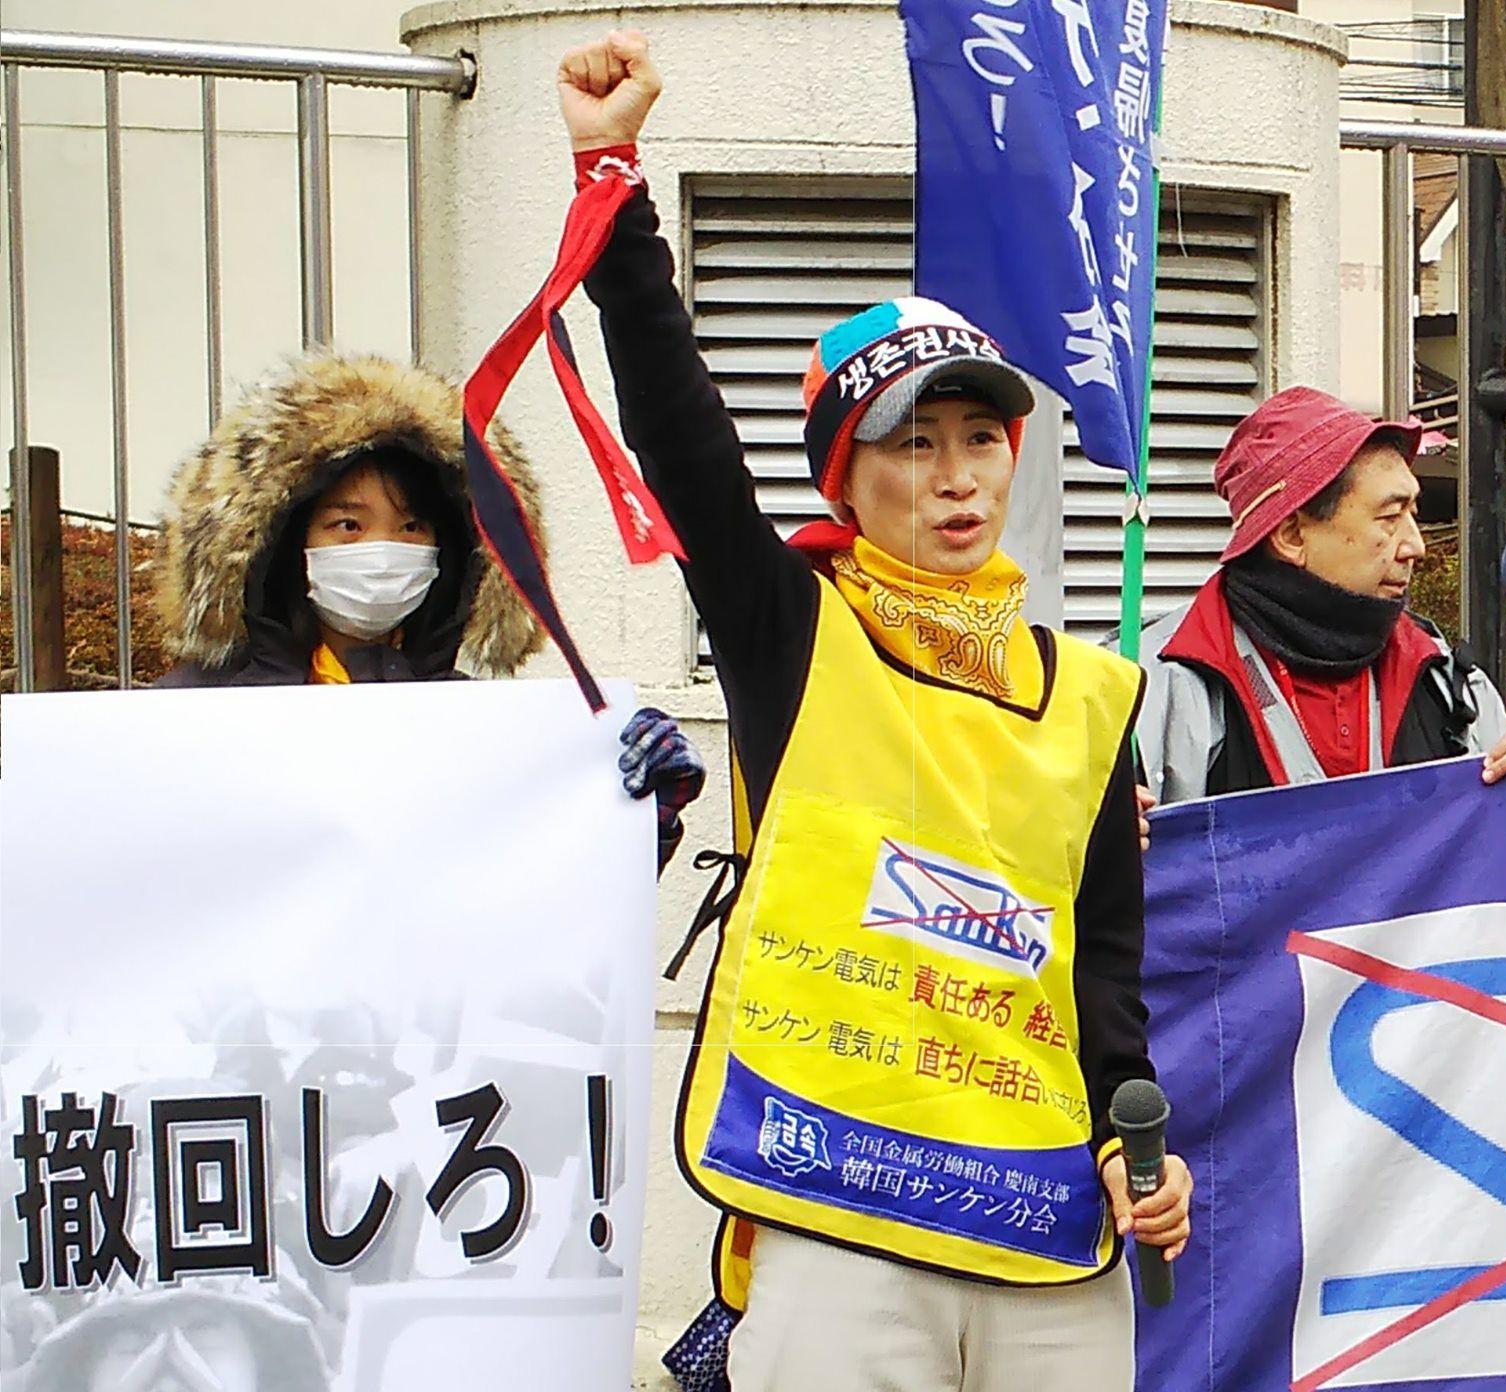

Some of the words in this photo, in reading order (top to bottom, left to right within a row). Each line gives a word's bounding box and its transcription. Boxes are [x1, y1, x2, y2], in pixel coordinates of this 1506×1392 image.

[870, 853, 1048, 971] SanKn
[908, 963, 1016, 1029] 責任ある
[13, 1073, 614, 1291] 撤回しろ!
[840, 1130, 1001, 1188] 全国金属労働組合
[1003, 1168, 1072, 1204] 慶南支部
[840, 1156, 1059, 1236] 韓国サンケン分会
